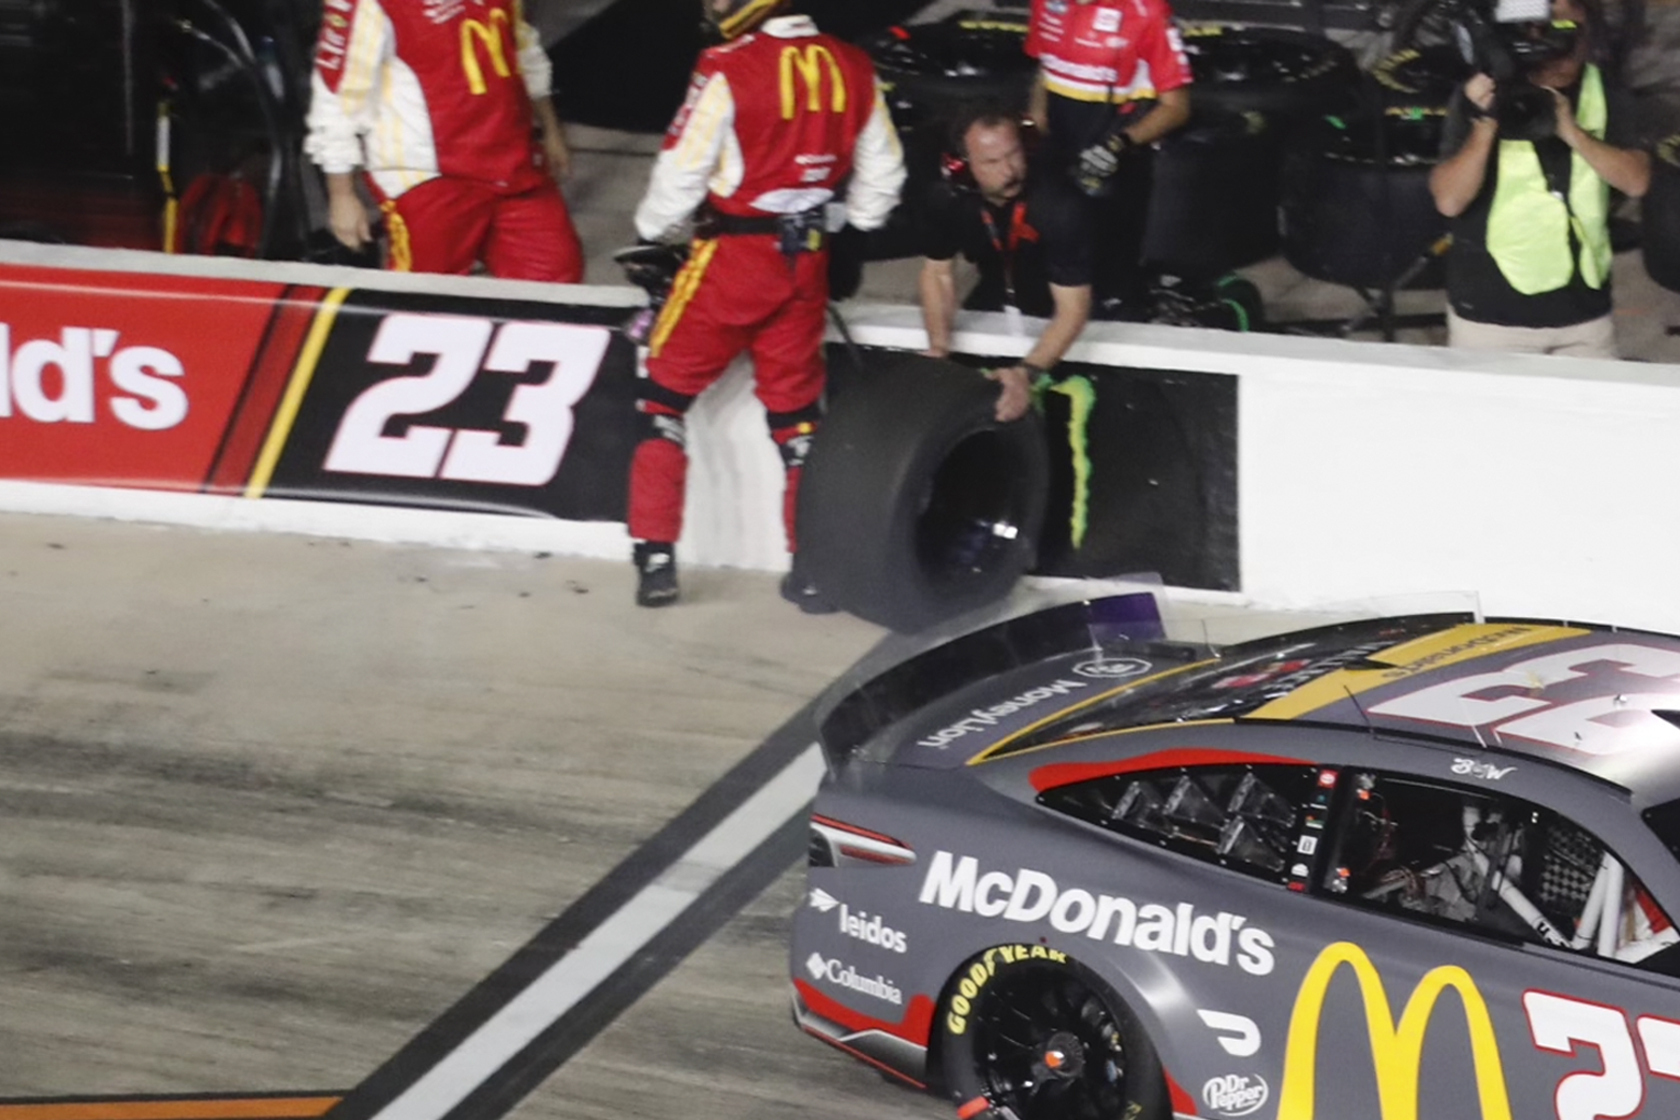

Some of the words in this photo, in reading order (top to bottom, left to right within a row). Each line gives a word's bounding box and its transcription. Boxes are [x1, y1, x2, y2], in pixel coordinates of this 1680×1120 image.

[322, 312, 611, 486] 23
[916, 678, 1088, 749] MoneyLion
[839, 902, 908, 954] leidos
[919, 850, 1277, 976] McDonald's
[826, 957, 903, 1006] Columbia
[1203, 1077, 1264, 1111] Pepper
[1225, 1073, 1250, 1092] Dr
